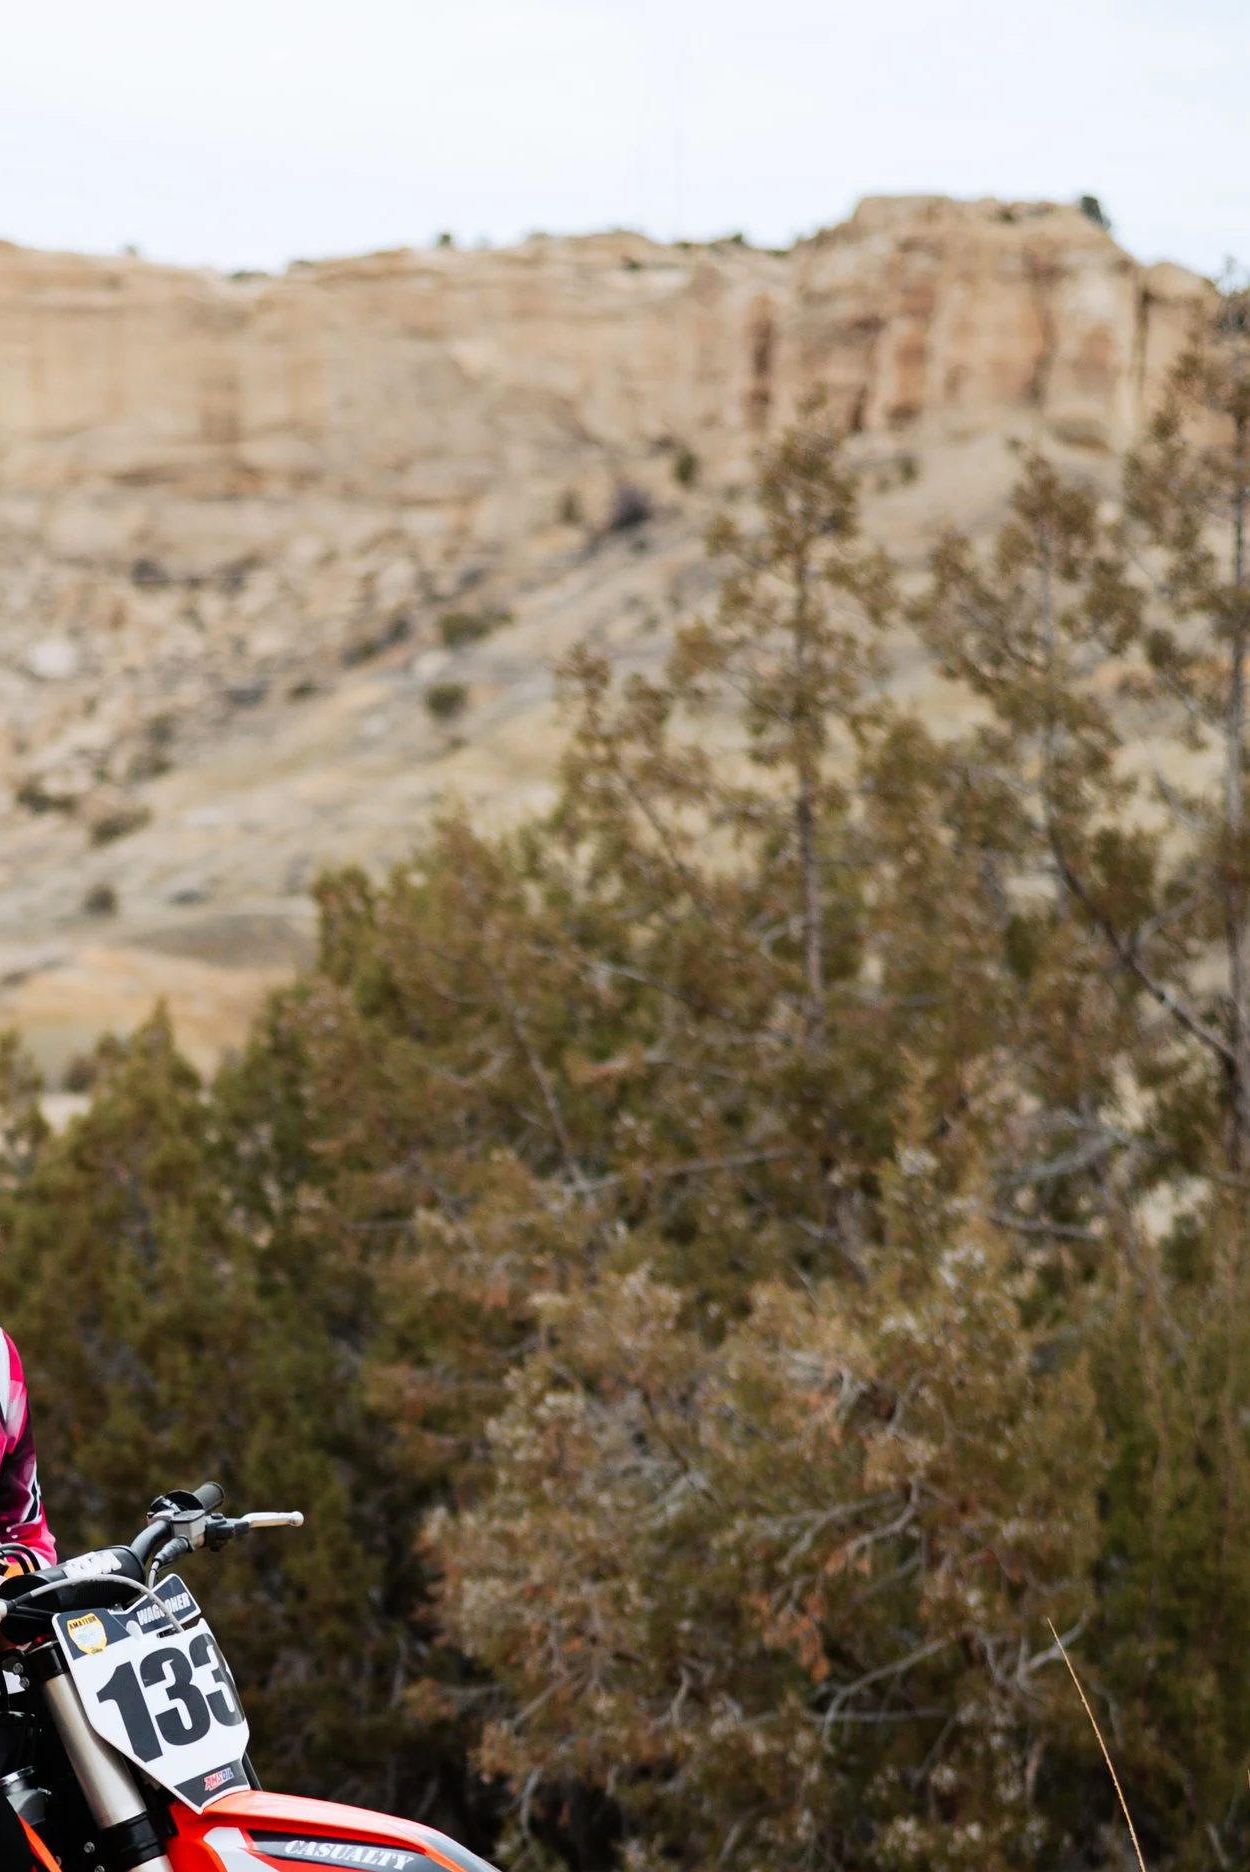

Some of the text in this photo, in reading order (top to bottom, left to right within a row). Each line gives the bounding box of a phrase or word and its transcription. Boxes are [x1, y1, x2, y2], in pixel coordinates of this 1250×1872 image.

[69, 1615, 97, 1630] AMATEUR
[136, 1592, 192, 1626] WAGONER
[96, 1632, 246, 1764] 133
[204, 1766, 234, 1791] AMSOIL
[284, 1839, 415, 1870] CASUALTY
